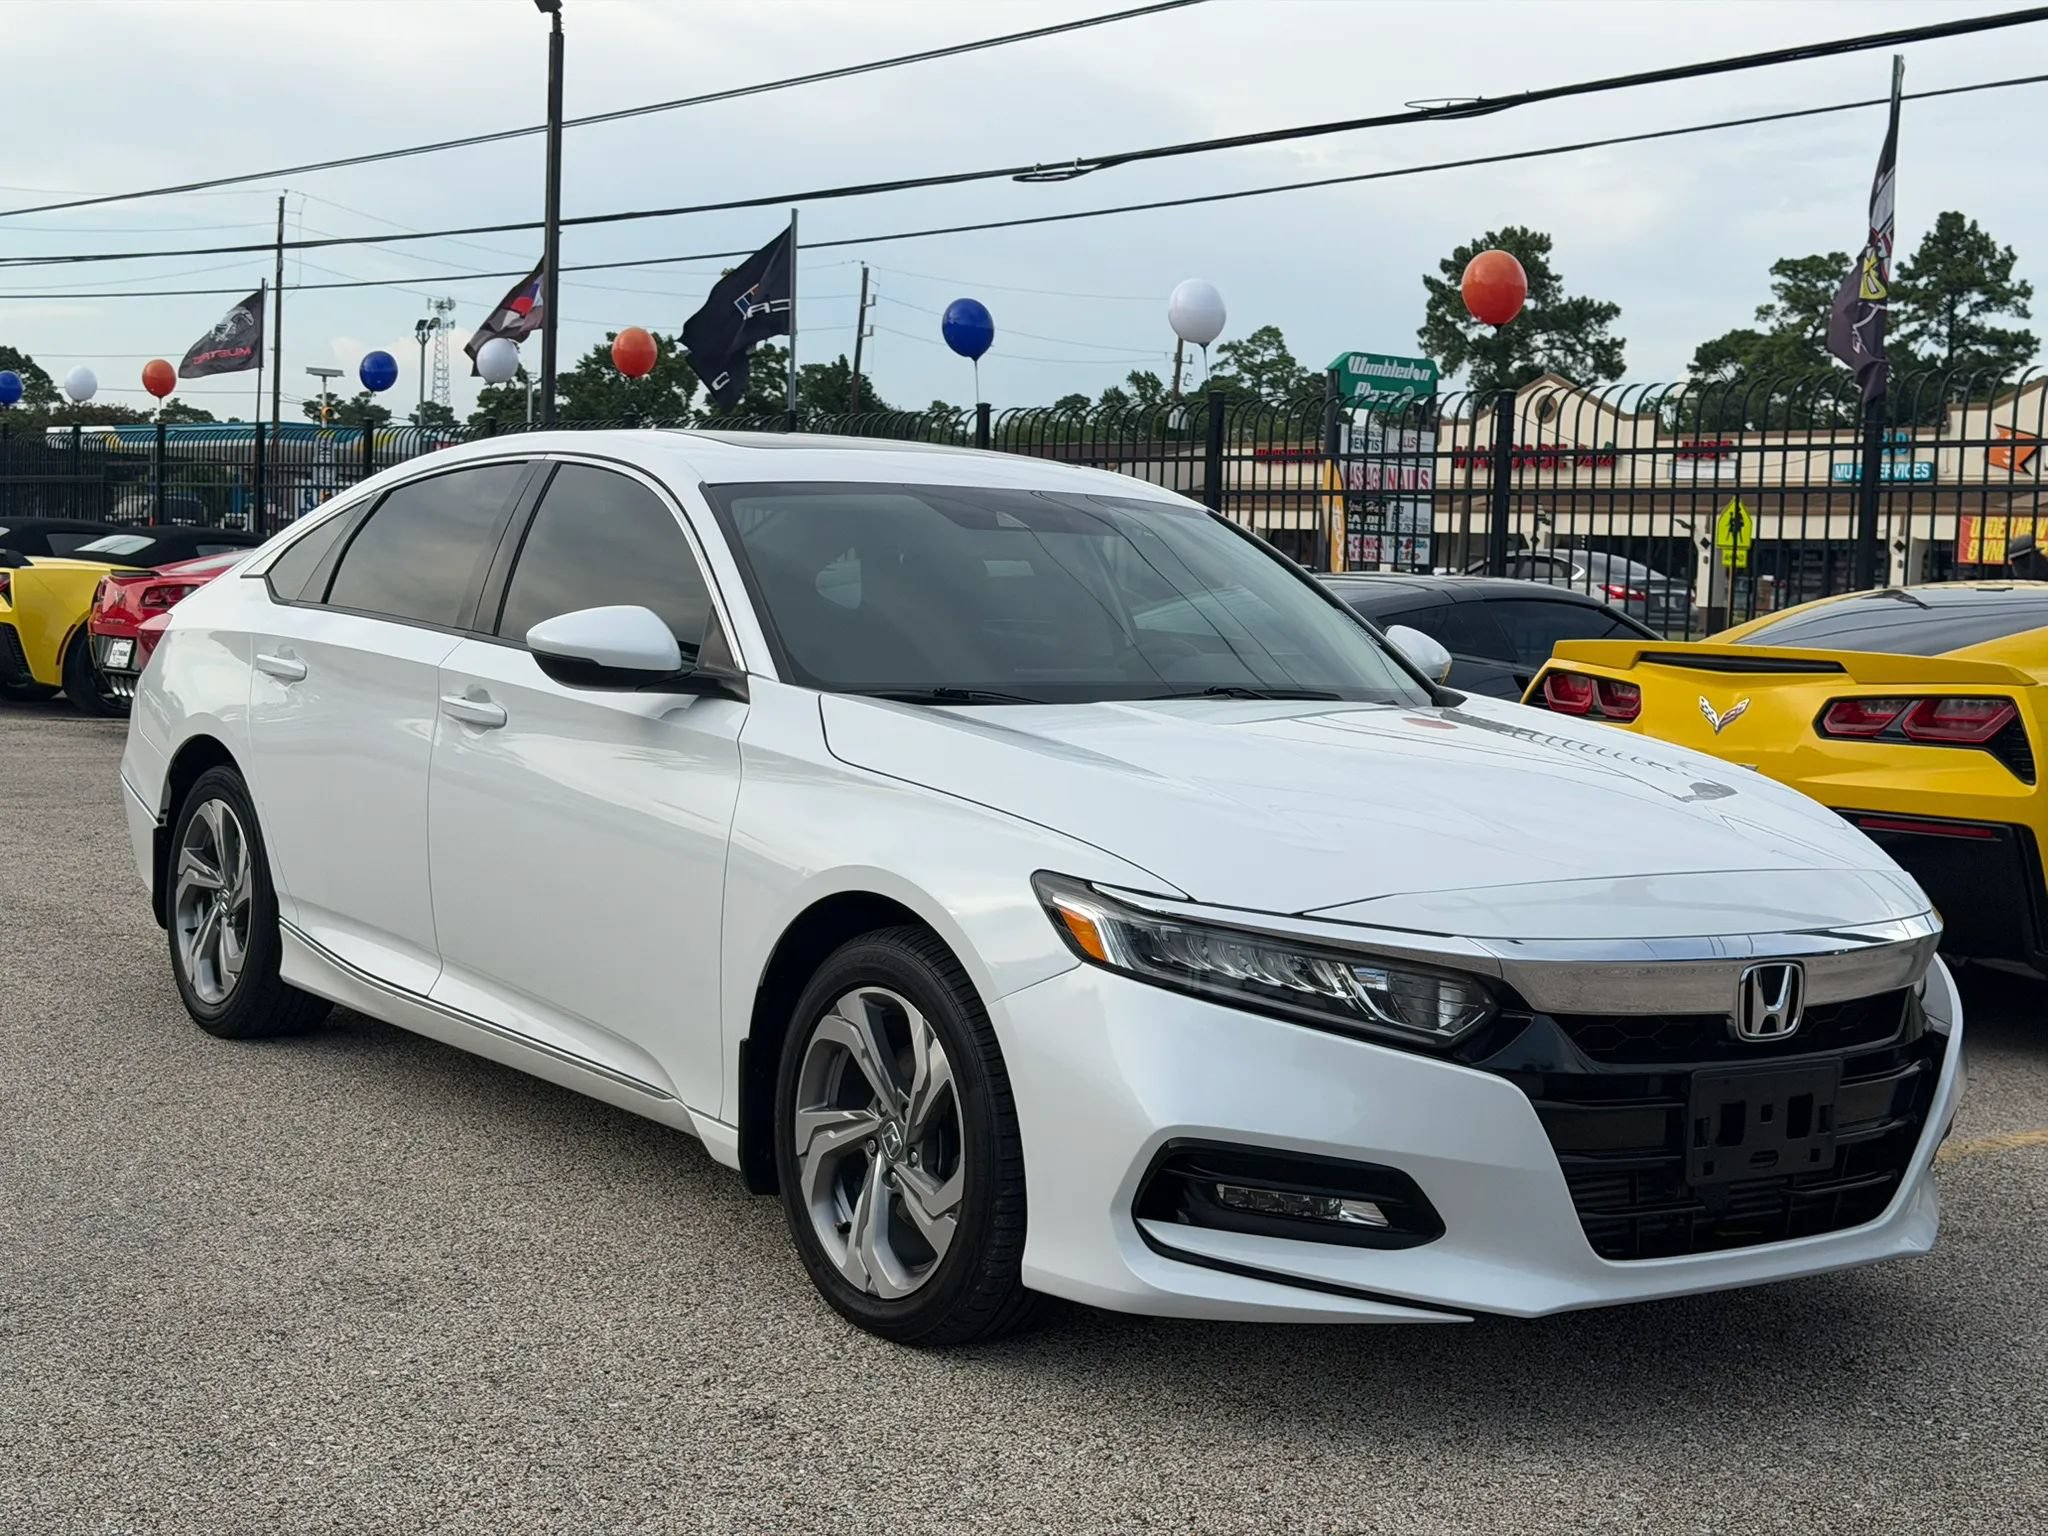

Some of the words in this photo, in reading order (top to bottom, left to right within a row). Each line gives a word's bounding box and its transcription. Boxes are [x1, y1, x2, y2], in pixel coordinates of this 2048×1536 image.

[1348, 355, 1431, 381] Wimbledon
[1347, 437, 1384, 451] ENTIS
[1877, 463, 1930, 479] ERVICES
